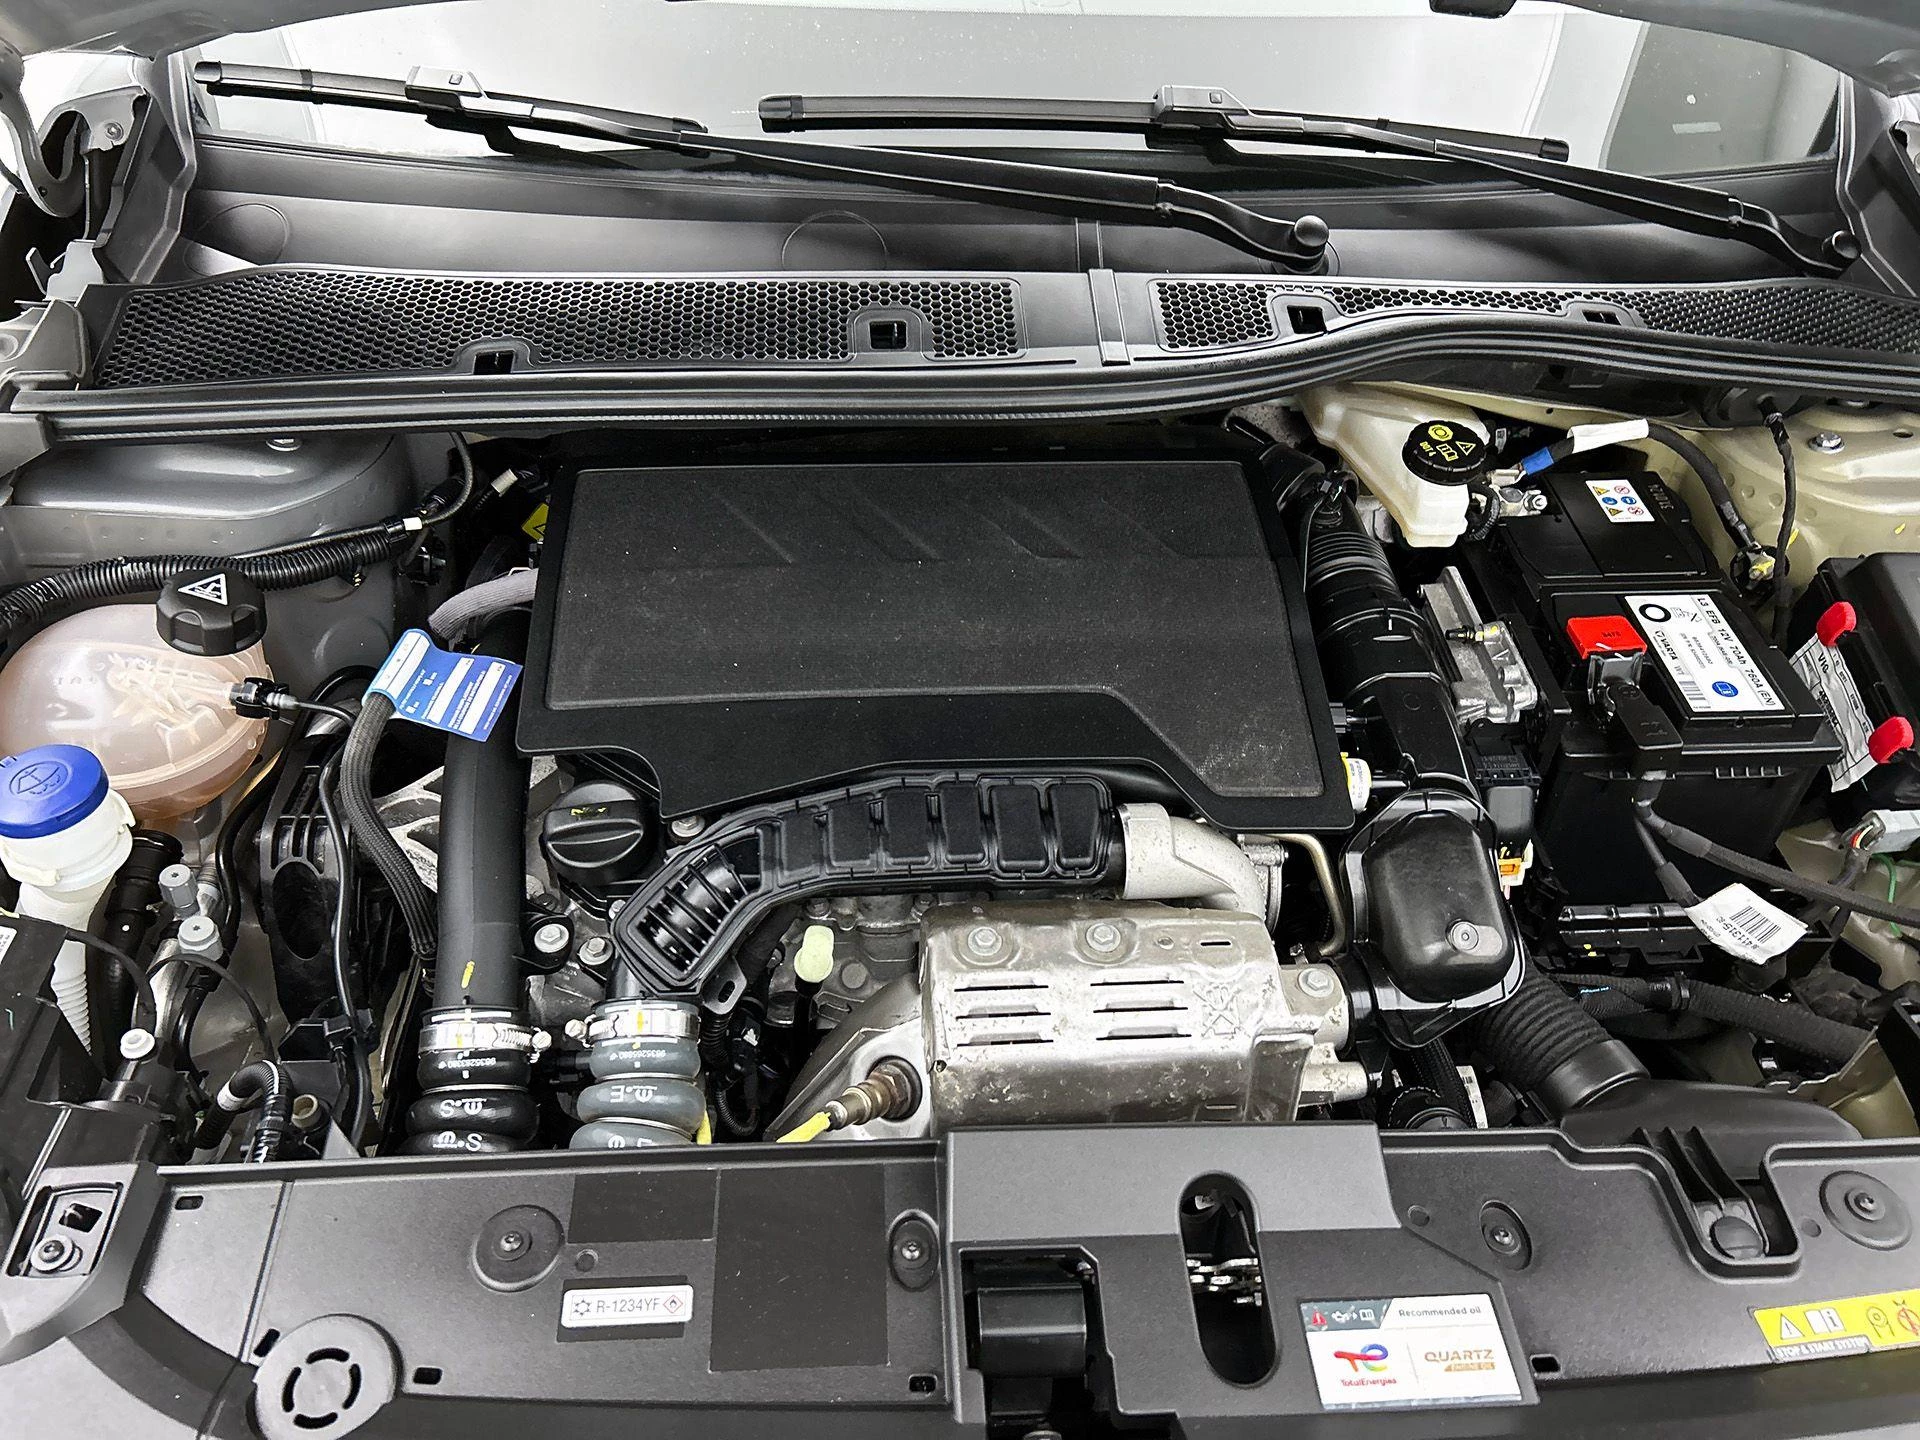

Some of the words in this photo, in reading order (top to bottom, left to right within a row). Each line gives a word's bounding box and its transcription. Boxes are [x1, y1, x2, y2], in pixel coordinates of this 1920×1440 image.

[1660, 634, 1678, 660] VARTA
[1697, 598, 1709, 607] L3
[1706, 610, 1720, 624] EFB
[1718, 628, 1733, 642] 12V
[1730, 645, 1746, 664] 70Ah
[1745, 668, 1763, 688] 760A
[596, 1297, 660, 1313] R-1234YF
[1399, 1307, 1467, 1317] Recommended
[1469, 1306, 1481, 1315] oil
[1424, 1349, 1494, 1363] QUARTZ
[1341, 1377, 1397, 1387] TotalEnergies
